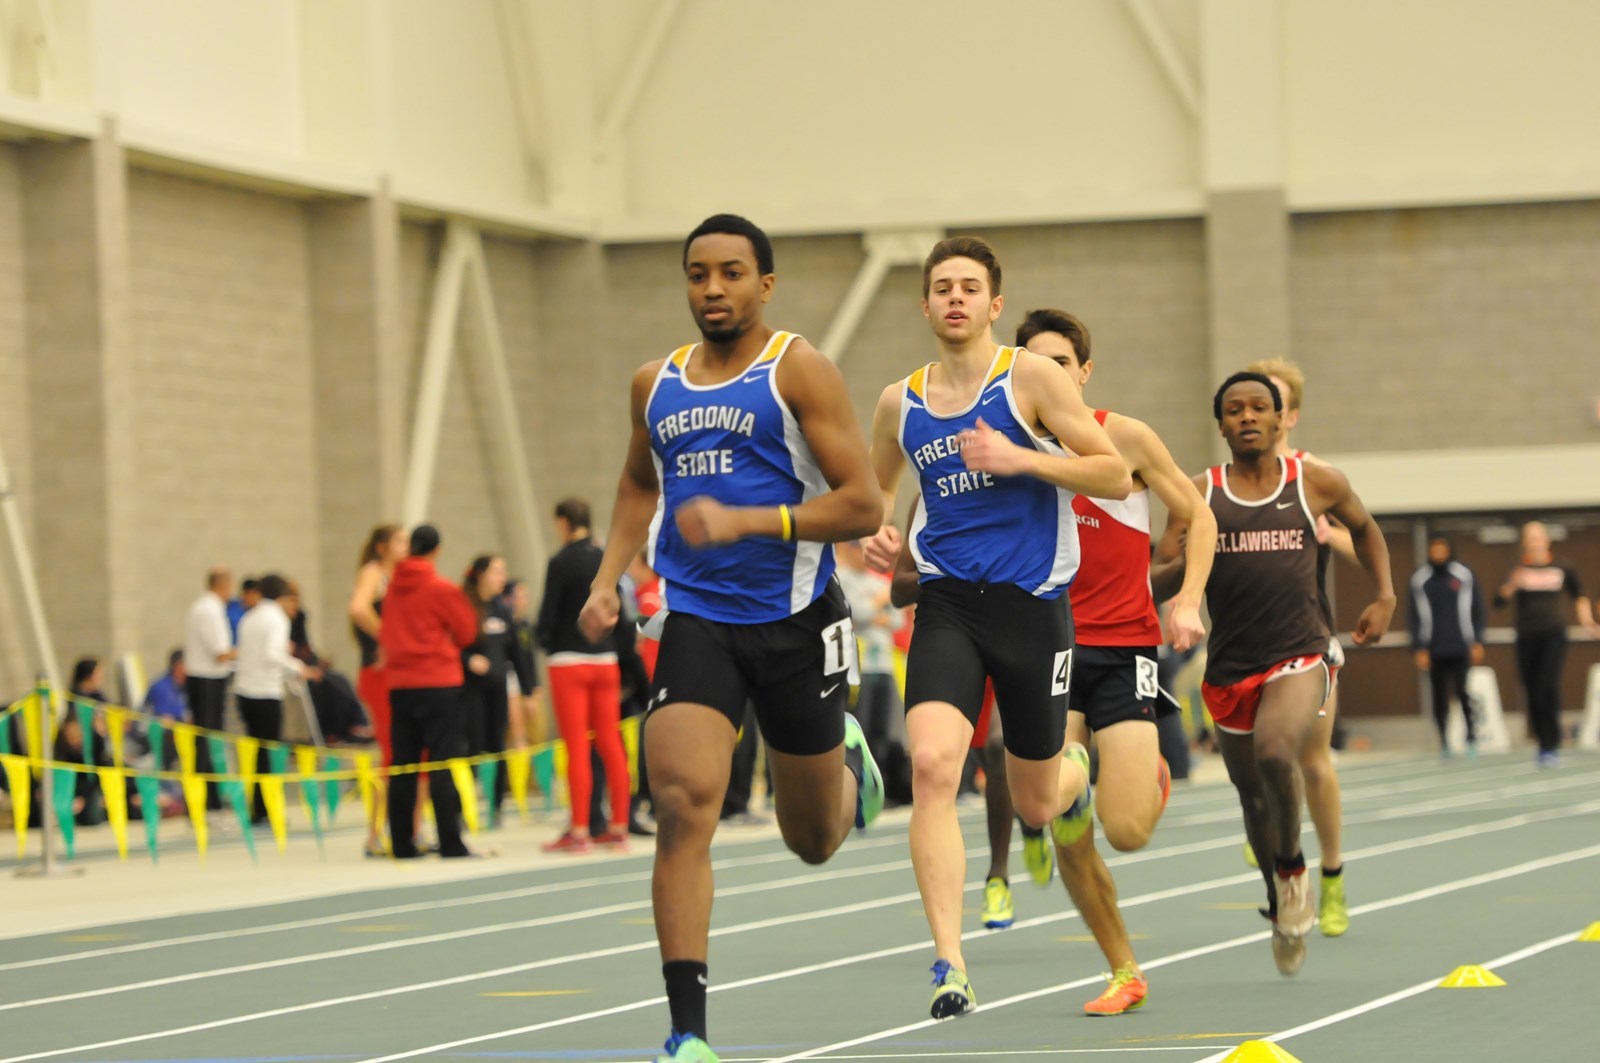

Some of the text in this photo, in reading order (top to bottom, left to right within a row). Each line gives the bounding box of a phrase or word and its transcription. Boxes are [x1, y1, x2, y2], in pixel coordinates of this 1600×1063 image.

[656, 405, 755, 445] FREDONIA
[676, 449, 734, 478] STATE
[913, 430, 977, 471] FRED
[936, 470, 995, 498] STATE
[829, 625, 844, 669] 1
[1055, 653, 1070, 691] 4
[1140, 660, 1156, 694] 3
